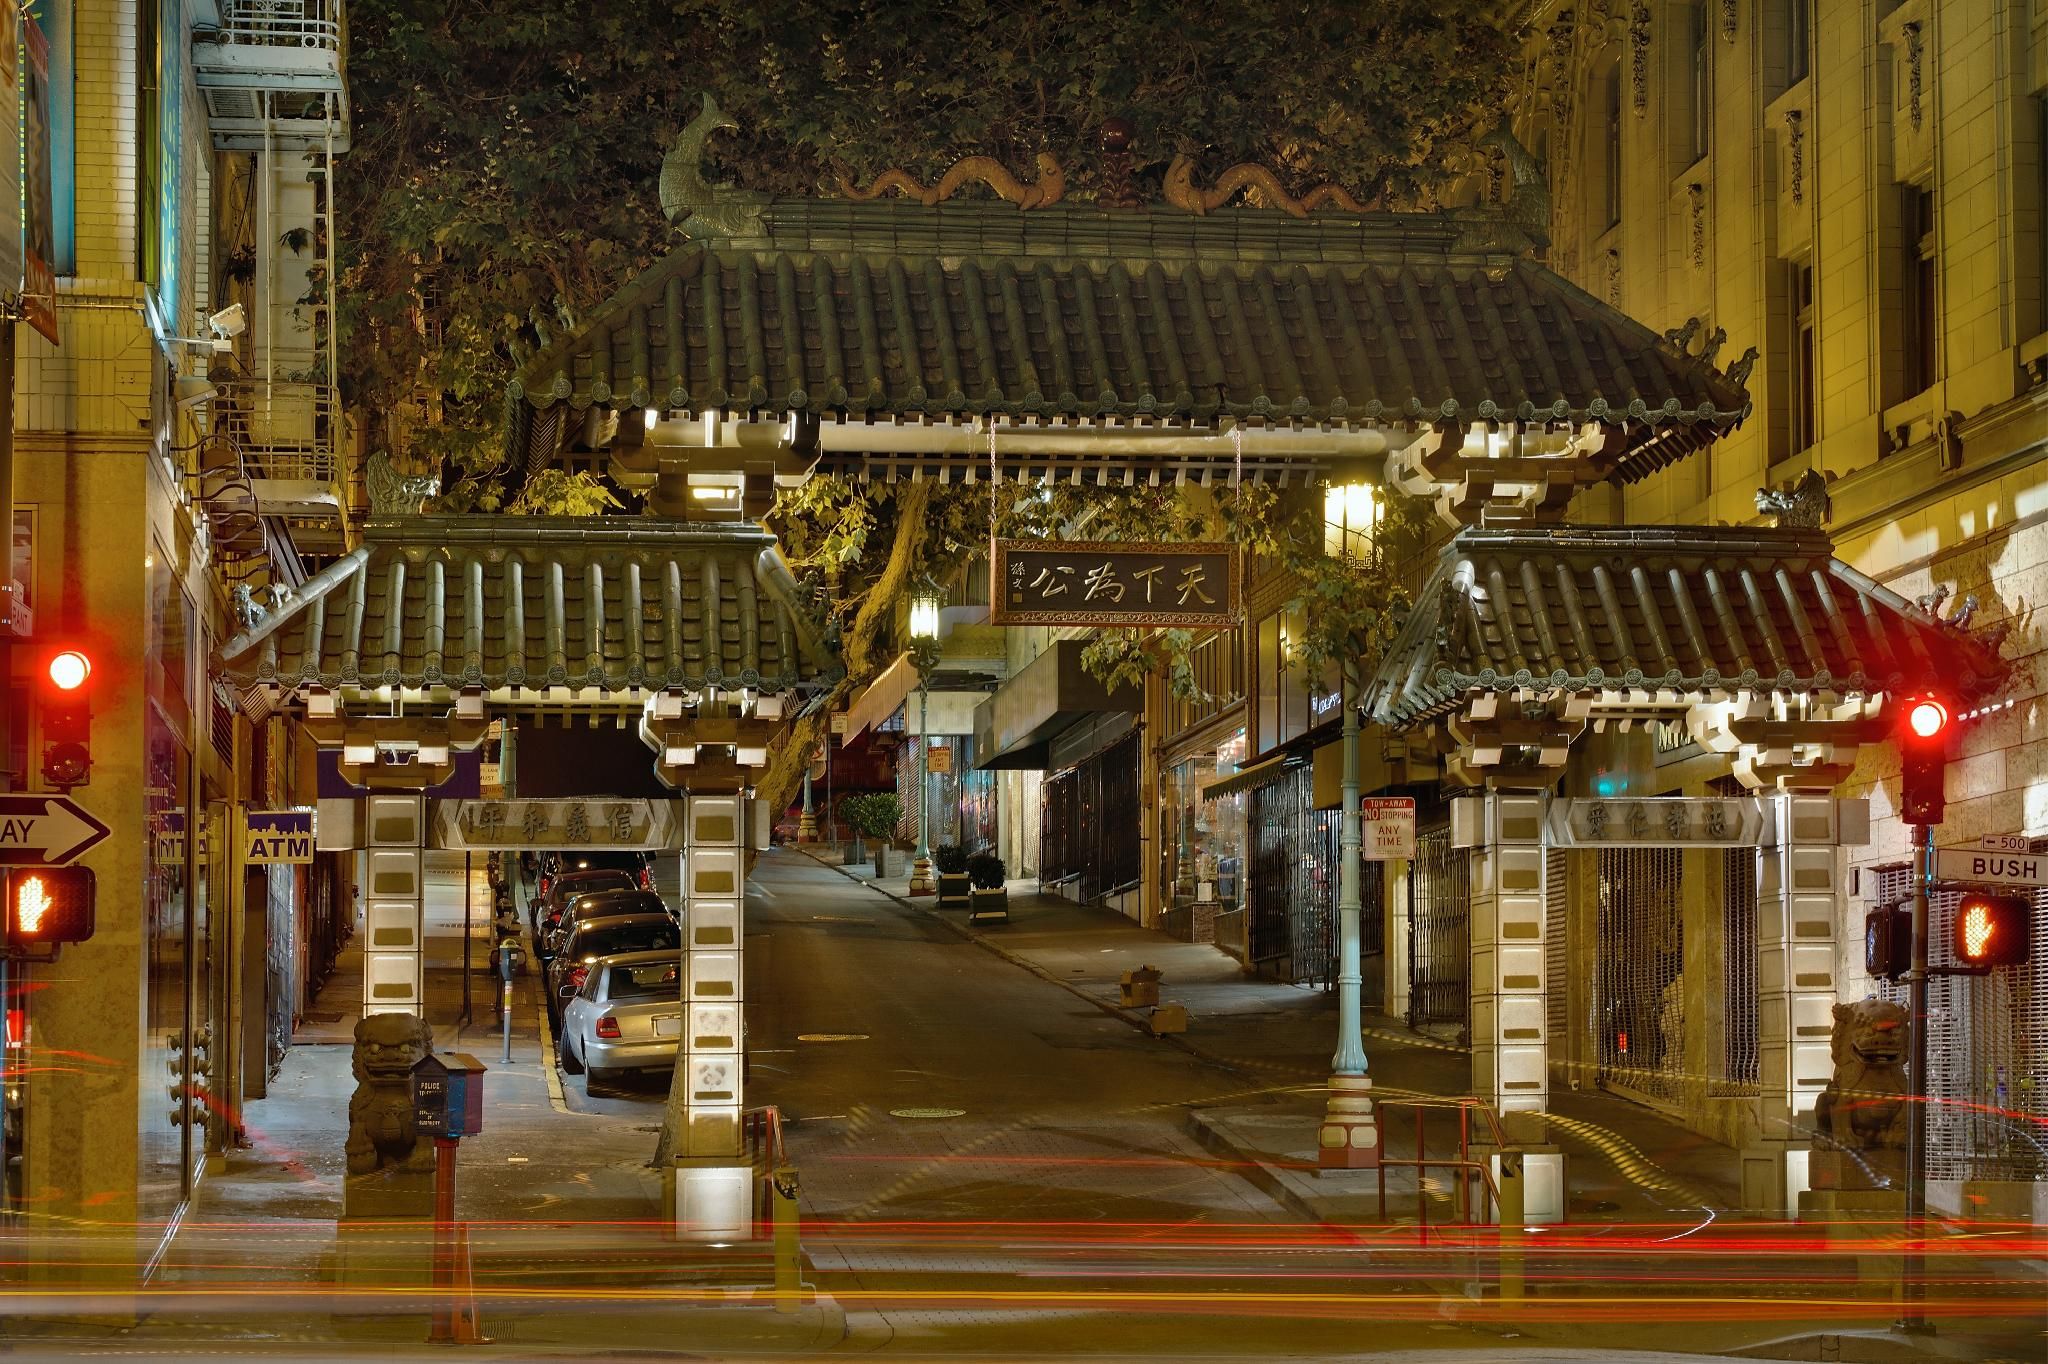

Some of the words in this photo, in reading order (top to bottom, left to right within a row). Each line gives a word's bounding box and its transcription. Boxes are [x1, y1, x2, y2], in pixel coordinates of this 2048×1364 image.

[1029, 561, 1217, 606] 天下為公
[1370, 800, 1407, 808] TOW-AWAY
[1364, 808, 1380, 820] NO
[1380, 810, 1413, 820] STOPPING
[1378, 825, 1400, 835] ANY
[1377, 837, 1402, 846] TIME
[2000, 837, 2025, 850] 500
[249, 838, 308, 858] ATM
[1972, 857, 2037, 879] BUSH
[420, 1082, 440, 1090] POLICE
